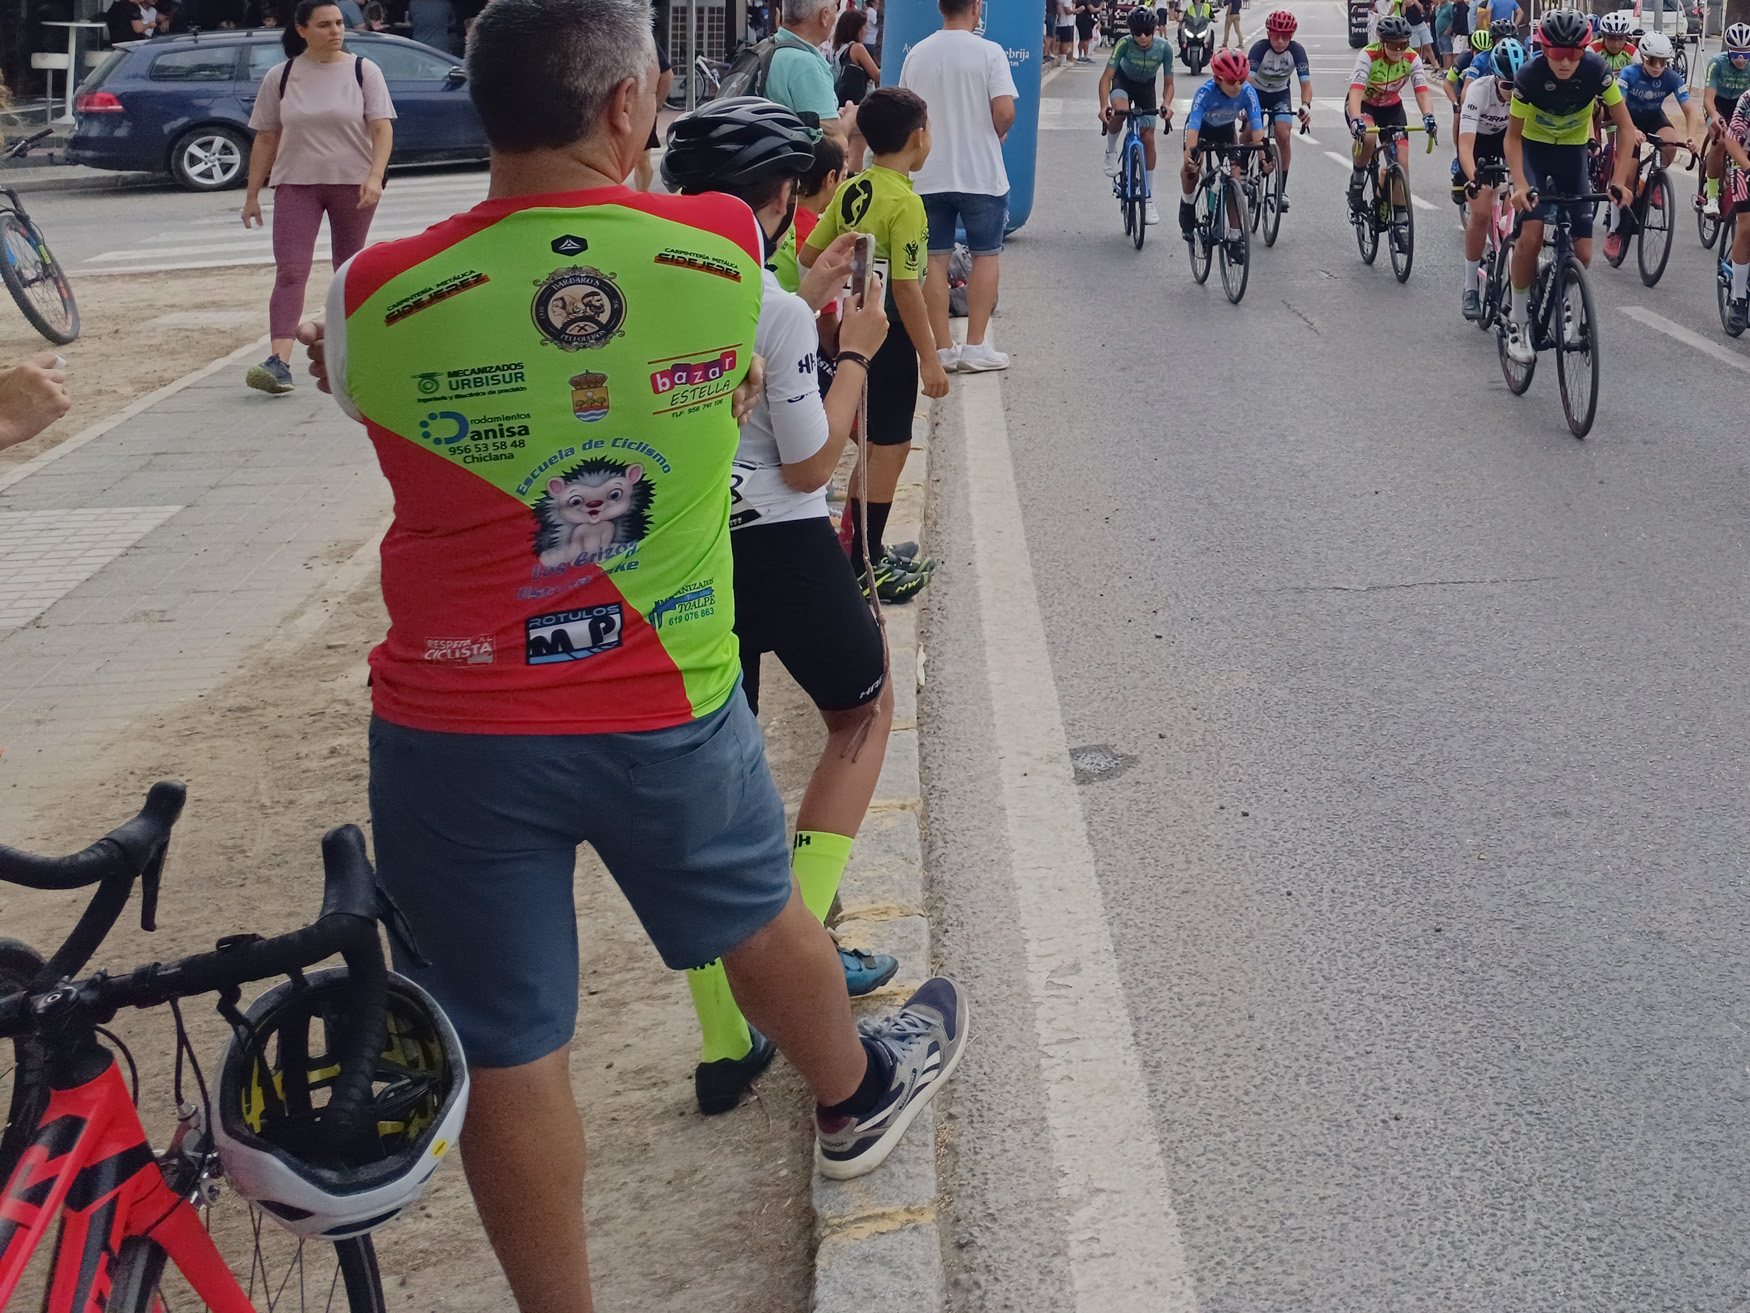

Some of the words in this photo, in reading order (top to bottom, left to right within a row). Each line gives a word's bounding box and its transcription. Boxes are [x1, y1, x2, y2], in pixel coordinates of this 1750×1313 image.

[447, 362, 525, 379] MECANIZADOS
[655, 356, 733, 392] bazar
[448, 371, 526, 391] URBISUR
[670, 379, 731, 406] ESTELLA
[470, 413, 531, 425] rodamientos
[449, 445, 472, 456] 956
[474, 443, 489, 453] 53
[492, 441, 508, 451] 58
[510, 439, 526, 448] 48
[463, 452, 515, 464] Chiclana
[516, 446, 575, 496] Escuela
[582, 439, 605, 451] de
[611, 437, 672, 474] Ciclismo
[678, 595, 716, 614] TOALPE
[529, 605, 620, 628] ROTULOS
[668, 616, 683, 626] 619
[684, 611, 699, 621] 076
[424, 642, 493, 661] CICLISTA
